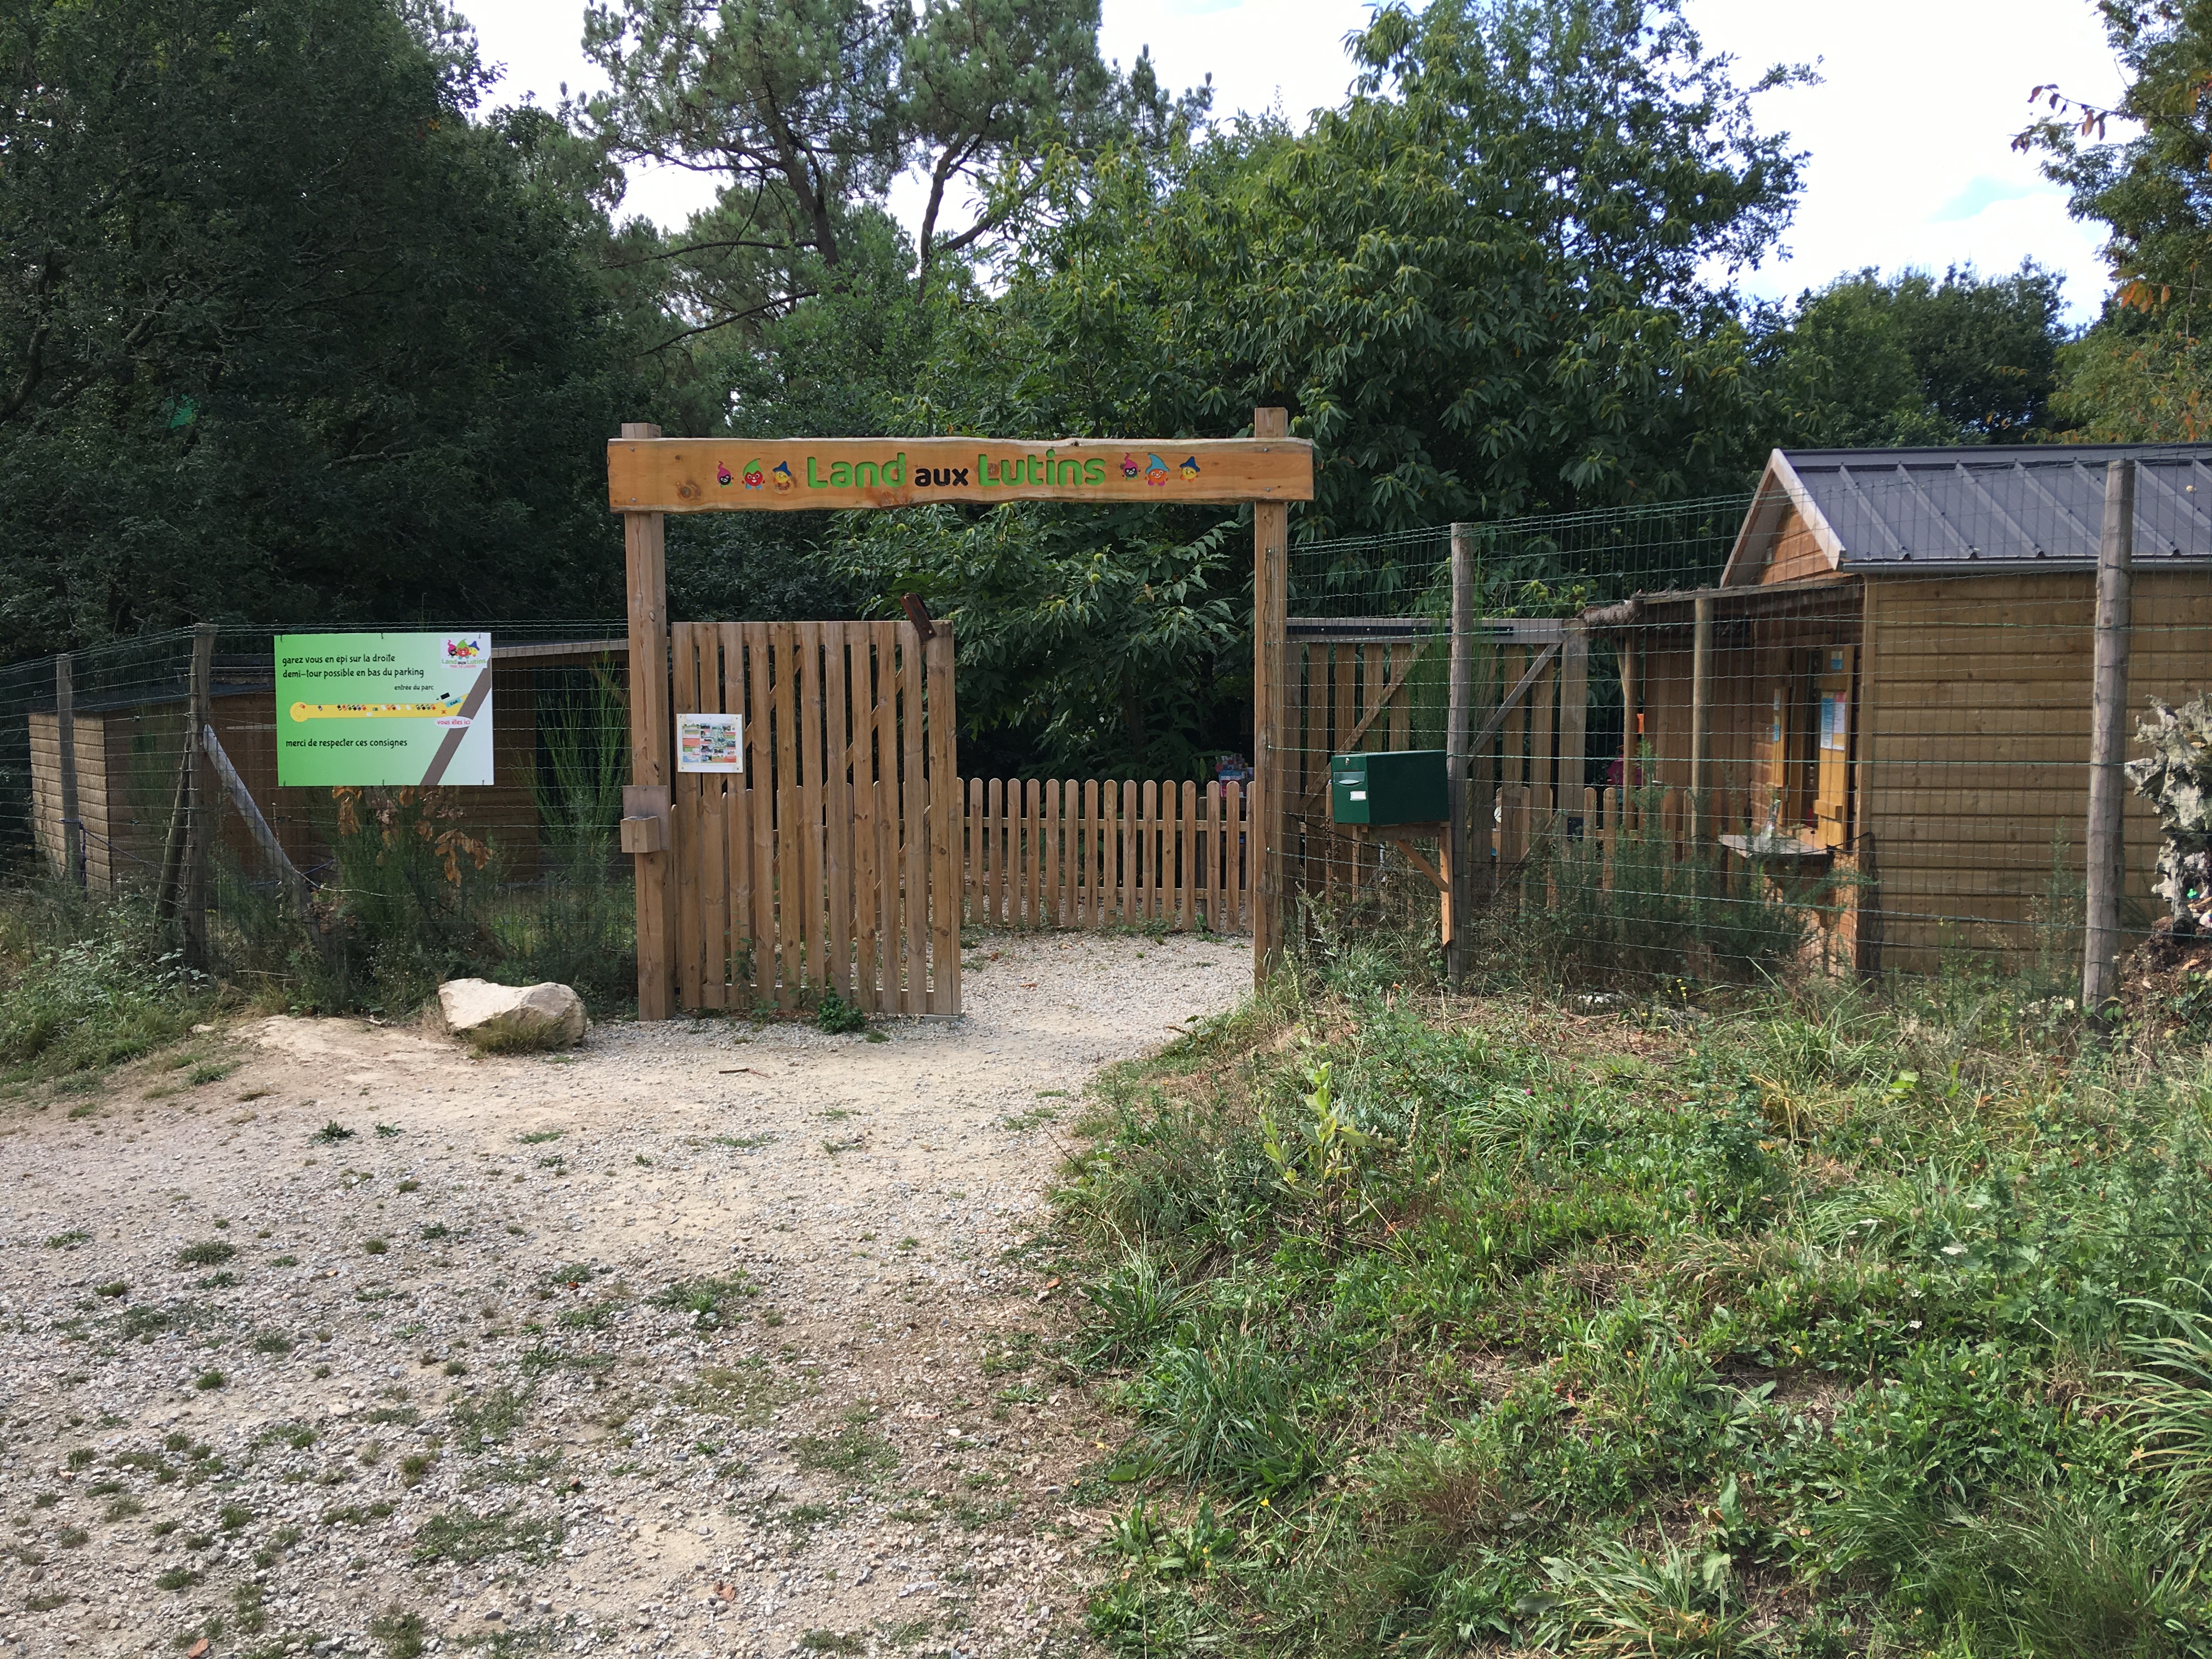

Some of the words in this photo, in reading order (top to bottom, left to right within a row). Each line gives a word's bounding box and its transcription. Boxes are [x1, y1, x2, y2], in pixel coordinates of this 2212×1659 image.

[807, 452, 906, 488] Land
[914, 467, 969, 487] aux
[978, 449, 1106, 487] Lutins
[283, 658, 303, 667] garez
[336, 655, 347, 665] épi
[364, 654, 370, 662] la
[283, 669, 322, 678] demi-tour
[324, 668, 354, 680] possible
[368, 668, 381, 676] bas
[382, 668, 392, 676] du
[394, 667, 424, 678] parking
[319, 738, 353, 748] respecter
[370, 739, 408, 749] consignes
